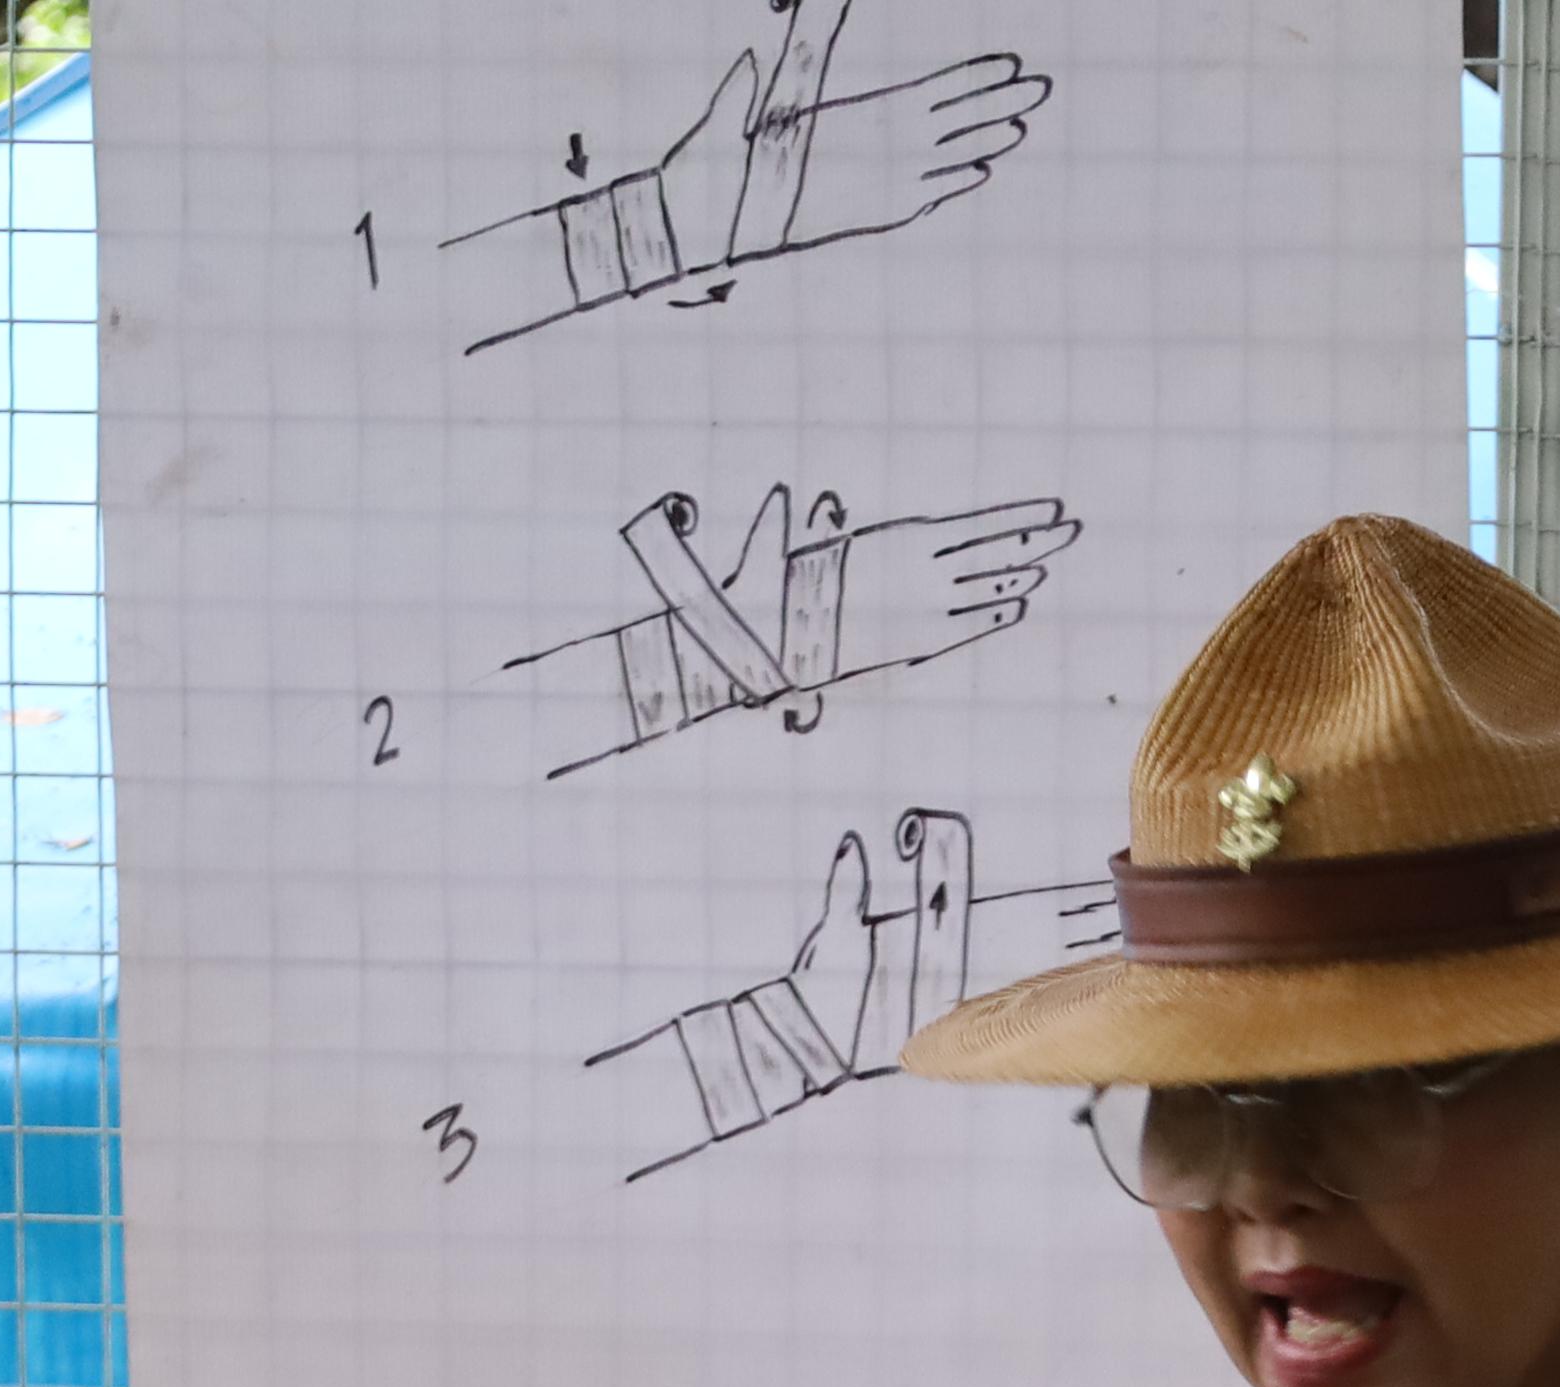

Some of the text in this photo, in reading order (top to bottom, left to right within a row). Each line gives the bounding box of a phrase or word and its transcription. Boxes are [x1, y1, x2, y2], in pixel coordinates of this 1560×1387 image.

[354, 210, 379, 291] 1
[363, 694, 400, 767] 2
[421, 1102, 478, 1184] 3
